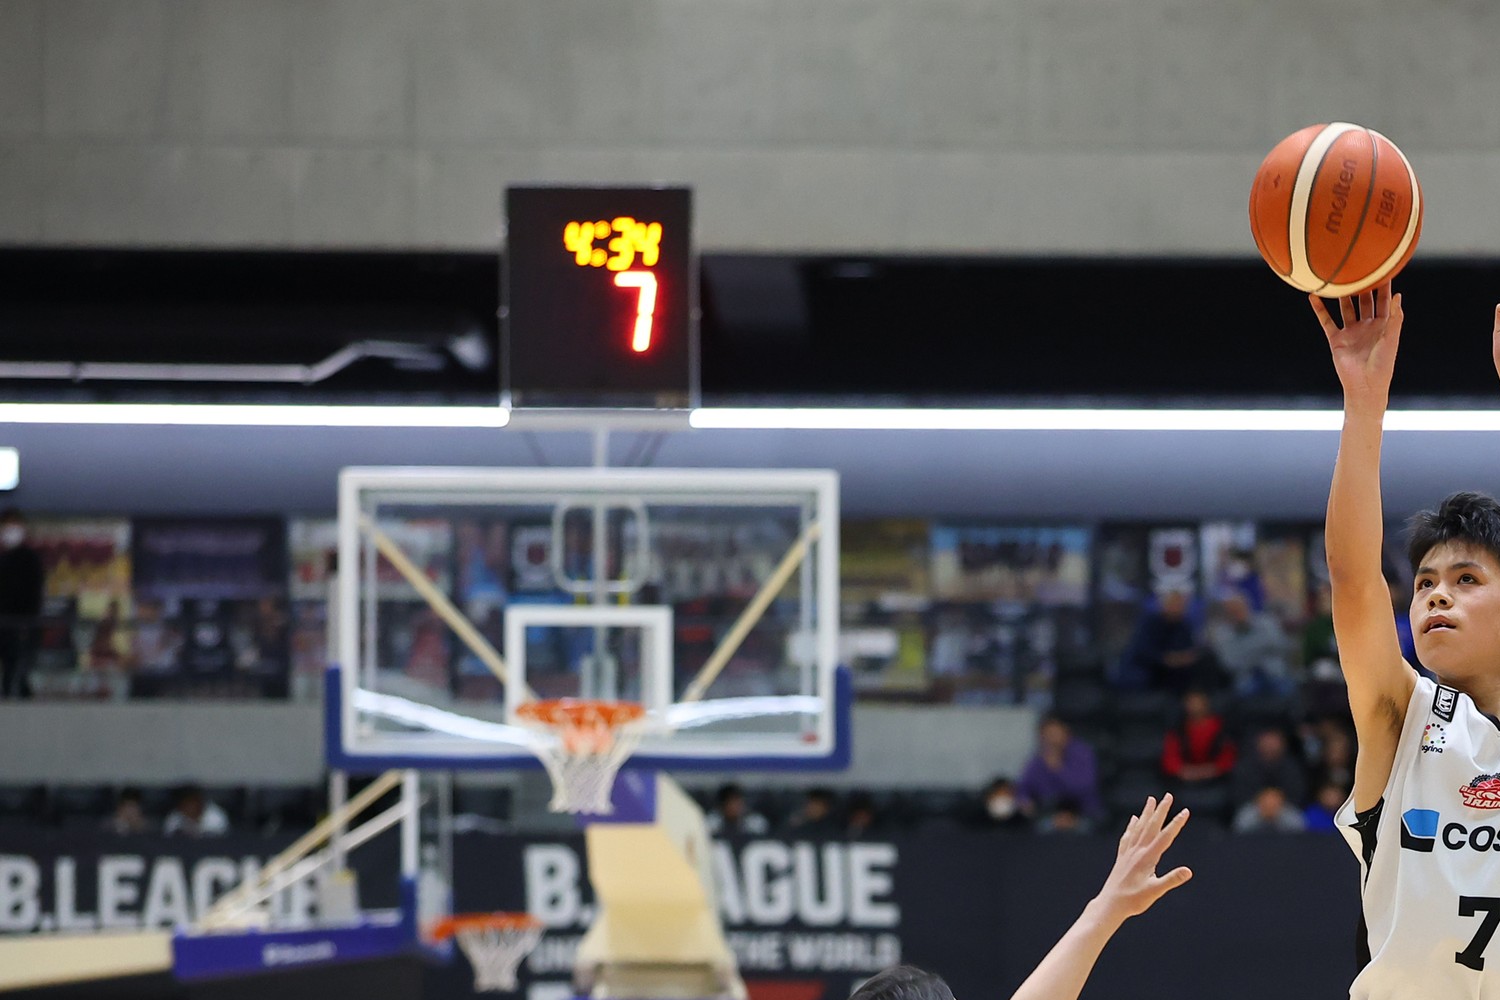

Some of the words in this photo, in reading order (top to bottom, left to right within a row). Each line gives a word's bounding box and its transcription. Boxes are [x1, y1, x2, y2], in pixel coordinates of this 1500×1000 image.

[1325, 159, 1358, 235] molten
[1375, 187, 1397, 228] FIBA
[563, 217, 662, 271] 4:34
[614, 271, 657, 352] 7
